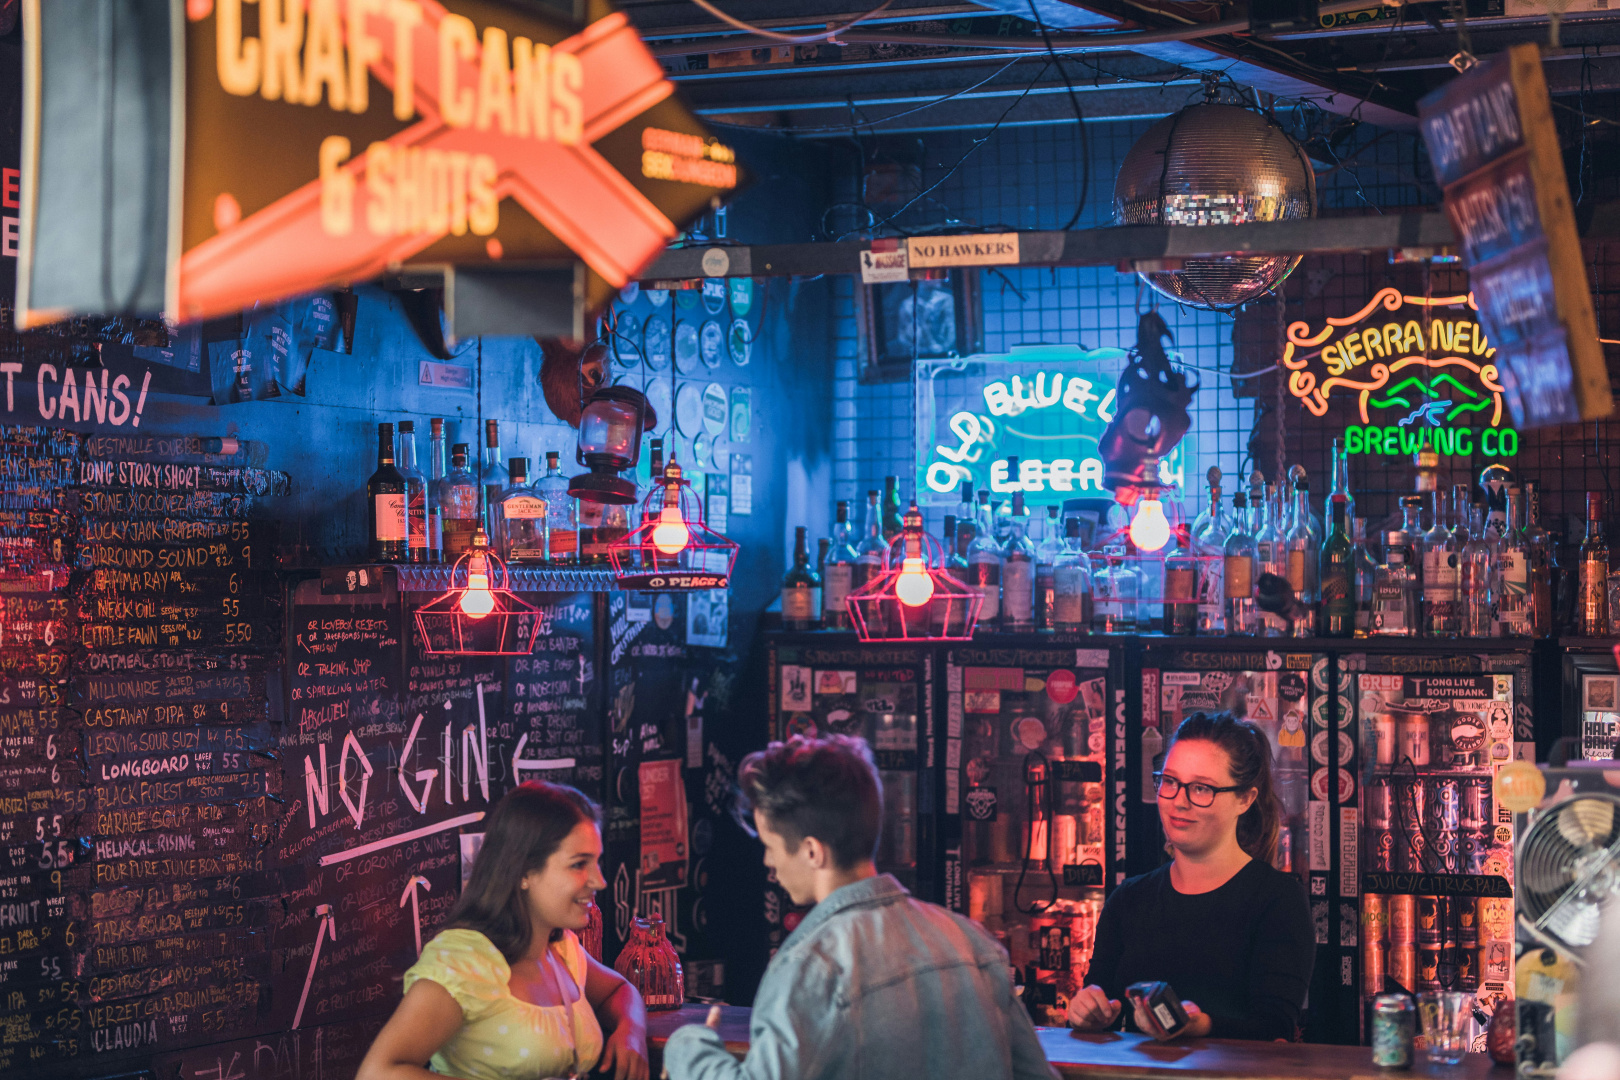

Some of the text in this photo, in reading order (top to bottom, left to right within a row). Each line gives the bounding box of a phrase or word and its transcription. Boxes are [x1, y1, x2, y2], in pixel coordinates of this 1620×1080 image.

[216, 0, 584, 144] CRAFT CANS
[366, 141, 499, 236] SHOTS
[914, 242, 1014, 257] NO HAWKERS
[317, 324, 325, 332] ALE
[1321, 319, 1425, 376] SIERRA
[37, 365, 152, 428] CANS!
[983, 371, 1099, 416] BLUE
[87, 436, 154, 457] WESTMALLE
[1344, 424, 1518, 457] BREWING CO
[925, 411, 981, 493] OLD
[81, 461, 200, 490] LONG STORY SHORT
[83, 492, 124, 512] STONE
[86, 517, 217, 542] LUCKY JACK GRAPEFRUIT
[81, 546, 209, 569] SURROUND SOUND
[209, 544, 228, 555] DIPA
[241, 545, 251, 569] 9
[215, 555, 233, 568] 8.2%
[95, 570, 169, 592] GAMMA RAY
[170, 570, 182, 582] APA
[229, 572, 238, 594] 6
[97, 600, 157, 619] NECK OIL
[160, 606, 182, 616] SESSION
[169, 613, 179, 621] IPA
[222, 598, 240, 617] 5.5
[12, 622, 33, 631] LAGER
[44, 621, 55, 647] 6
[160, 623, 187, 634] SESSION
[186, 628, 202, 641] 4.2%
[225, 623, 252, 644] 5.50
[321, 618, 388, 631] LOVEBOX REJECTS
[81, 625, 158, 647] LITTLE FAWN
[169, 635, 179, 646] IPA
[38, 653, 59, 676] 5.5
[89, 652, 195, 672] OATMEAL STOUT
[230, 653, 248, 671] 5.5
[315, 658, 372, 679] TALKING SHOP
[1181, 652, 1264, 669] SESSION IPA
[1382, 656, 1444, 673] SESSION
[18, 680, 36, 689] LAGER
[89, 679, 162, 701] MILLIONAIRE
[165, 675, 193, 688] SALTED
[165, 686, 196, 698] CARAMEL
[195, 679, 213, 690] STOUT
[306, 677, 388, 699] SPARKLING WATER
[1280, 686, 1304, 695] HOWLING
[1426, 678, 1475, 687] LONG LIVE
[1284, 692, 1299, 700] HOPS
[1426, 688, 1488, 697] SOUTHBANK.
[85, 706, 185, 728] CASTAWAY DIPA
[192, 704, 206, 719] 8%
[220, 702, 229, 720] 9
[299, 699, 350, 735] ABSOLUTELY
[1456, 716, 1480, 727] GOOSE
[225, 727, 244, 749] 5.5
[1584, 721, 1616, 736] HALF
[6, 736, 34, 746] PALE ALE
[46, 734, 57, 761] 6
[88, 728, 200, 757] LERVIG SOUR SUZY
[397, 682, 490, 816] GIN
[1456, 739, 1481, 749] ISLAND
[102, 754, 189, 781] LONGBOARD
[194, 752, 213, 762] LAGER
[222, 752, 242, 770] 5.5
[186, 773, 239, 788] CHERRY CHOCOLATE
[240, 772, 261, 794] 7.5
[303, 729, 374, 831] NO
[96, 780, 184, 810] BLACK FOREST
[200, 786, 225, 799] STOUT
[257, 796, 267, 818] 9
[36, 815, 62, 841] 5.5
[97, 806, 190, 836] GARAGE SOUP
[95, 833, 197, 861] HELIACAL RISING
[97, 857, 221, 883] FOUR PURE JUICE BOX
[255, 849, 264, 872] 6
[357, 849, 402, 875] CORONA
[50, 870, 61, 894] 9
[233, 876, 241, 900] 6
[1474, 879, 1508, 894] PALE
[46, 896, 65, 905] WHEAT
[190, 917, 203, 929] ALE
[225, 905, 244, 926] 5.5
[17, 929, 34, 940] DARK
[94, 914, 184, 943] TARAS BOULBA
[97, 944, 148, 967] RHUB IPA
[88, 1001, 142, 1029] VERZET
[175, 990, 210, 1013] BRUIN
[169, 1014, 188, 1026] WHEAT
[90, 1019, 158, 1053] CLAUDIA
